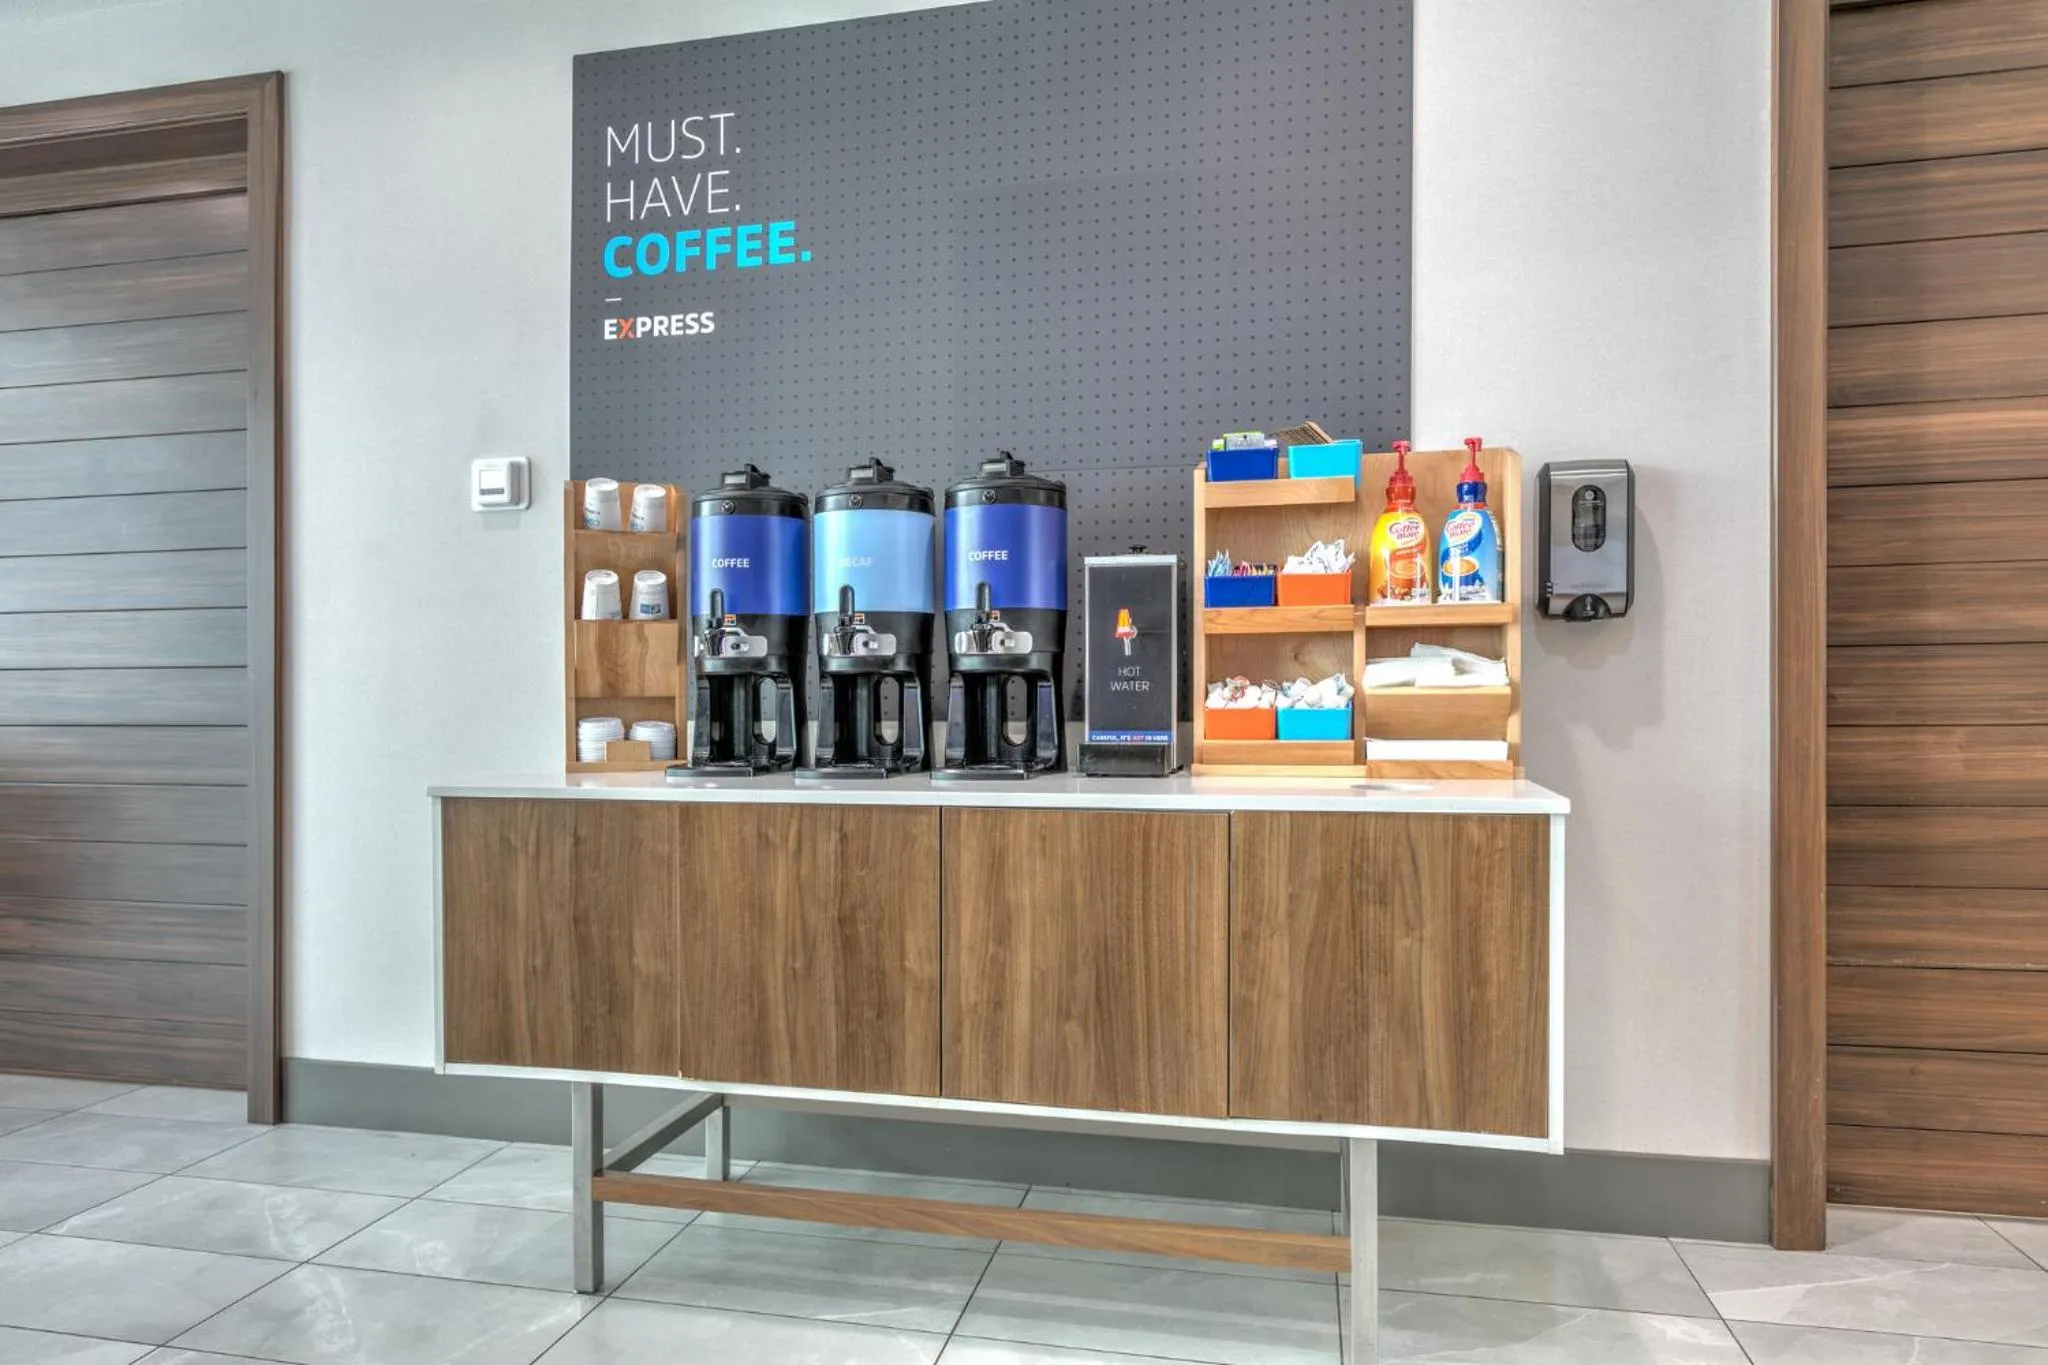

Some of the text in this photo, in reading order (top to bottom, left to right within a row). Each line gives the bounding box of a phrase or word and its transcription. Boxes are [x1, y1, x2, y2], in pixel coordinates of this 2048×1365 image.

[606, 112, 741, 167] MUST.
[606, 169, 741, 223] HAVE.
[603, 219, 812, 279] COFFEE.
[604, 311, 715, 340] EXPRESS
[712, 557, 750, 569] COFFEE
[968, 550, 1009, 561] COFFEE
[1118, 665, 1141, 677] HOT
[1110, 680, 1150, 692] WATER
